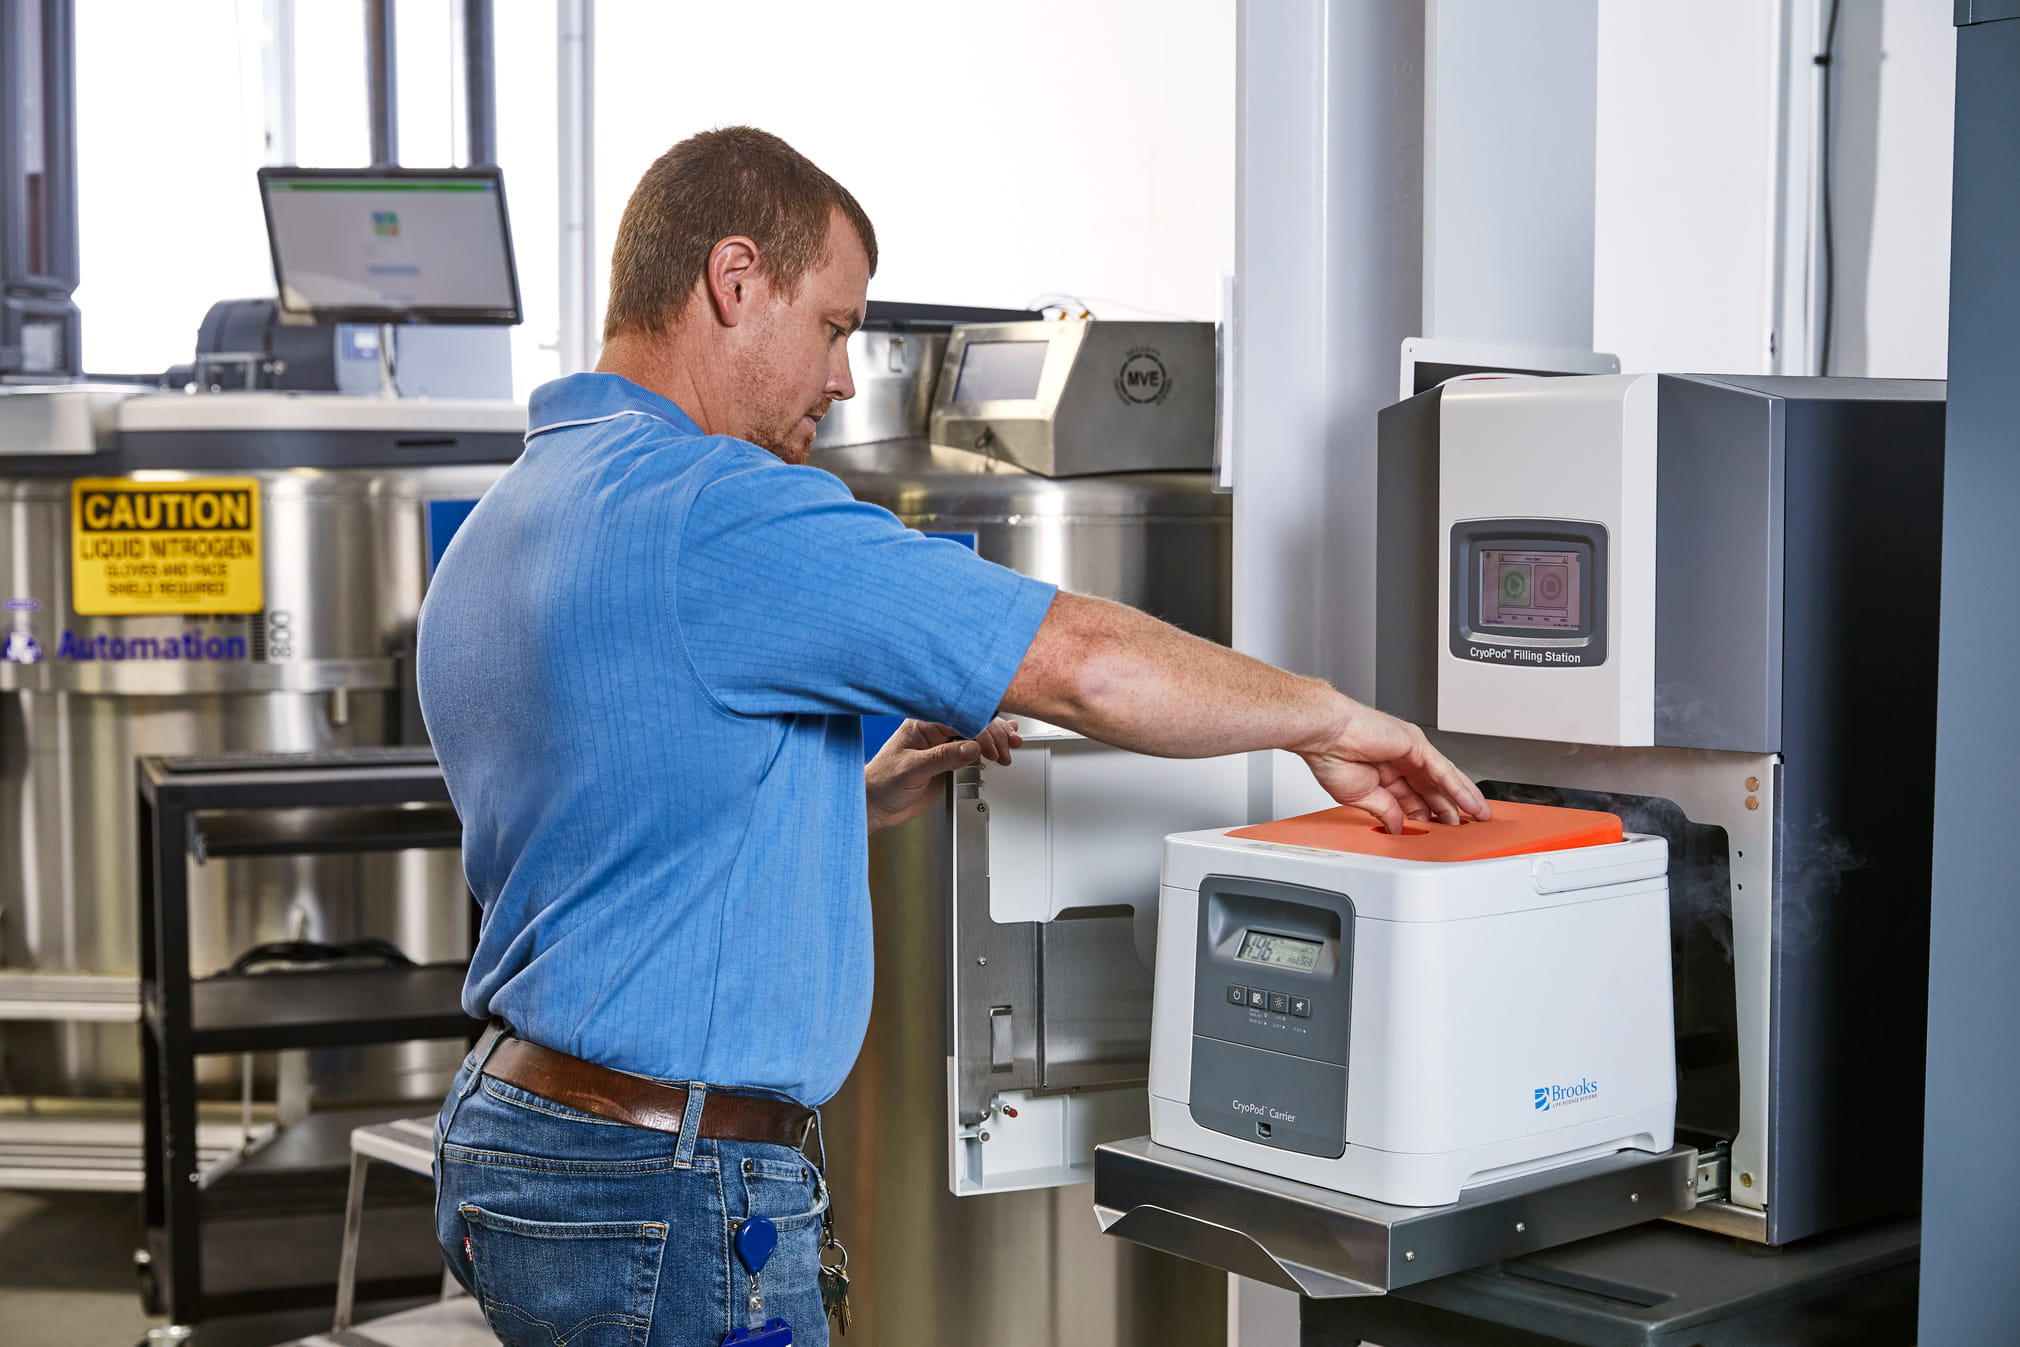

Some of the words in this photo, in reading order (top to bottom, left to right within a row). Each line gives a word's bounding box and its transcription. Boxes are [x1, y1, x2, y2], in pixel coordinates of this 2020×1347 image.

[1127, 371, 1159, 387] MVE
[85, 492, 249, 529] CAUTION
[81, 537, 144, 560] LIQUID
[150, 536, 254, 560] NITROGEN
[107, 563, 157, 577] GLOVES
[163, 563, 188, 577] AND
[193, 563, 228, 577] FACE
[107, 581, 153, 596] SHIELD
[160, 581, 226, 596] REQUIRED
[58, 629, 247, 660] Automation
[1513, 649, 1543, 663] Filling
[1545, 651, 1581, 663] Station
[1551, 1078, 1597, 1101] Brooks
[1269, 1108, 1296, 1123] Carrier
